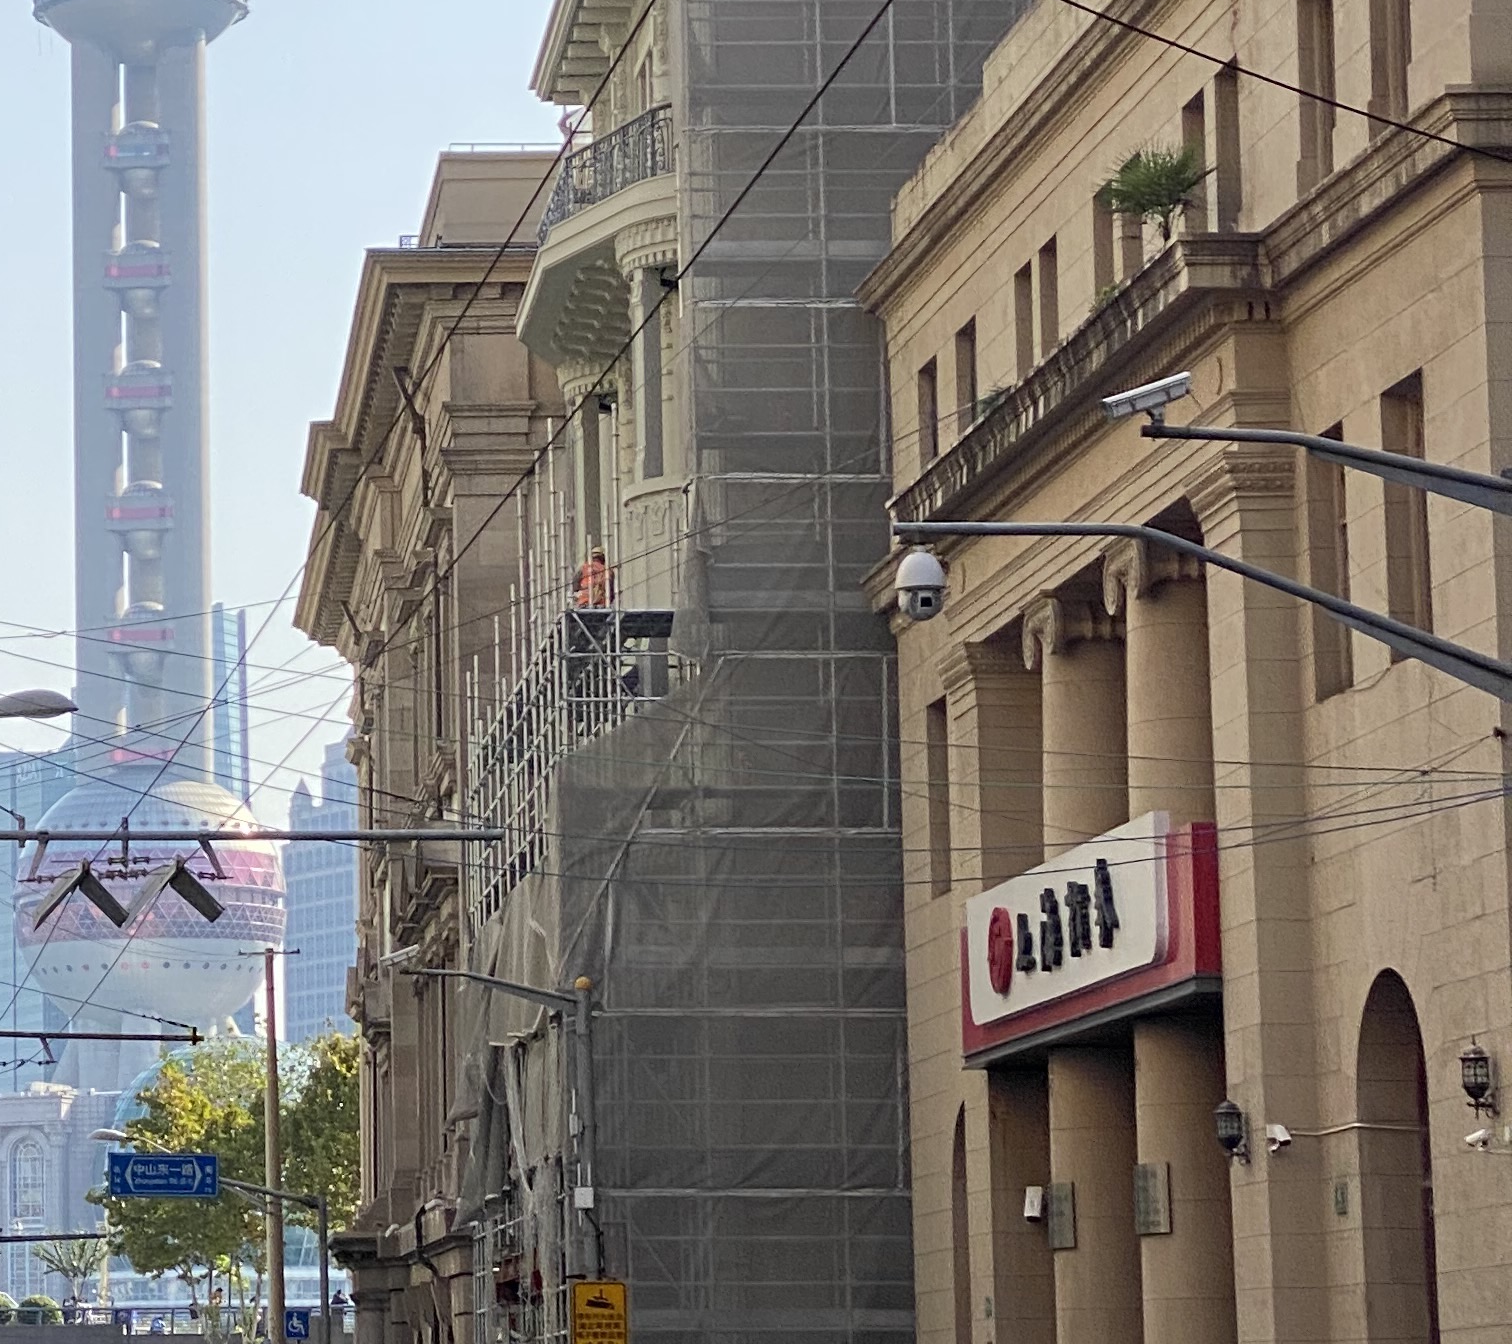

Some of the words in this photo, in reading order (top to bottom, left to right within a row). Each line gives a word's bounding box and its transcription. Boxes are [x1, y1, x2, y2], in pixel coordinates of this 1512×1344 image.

[133, 1163, 193, 1177] 中山东一路
